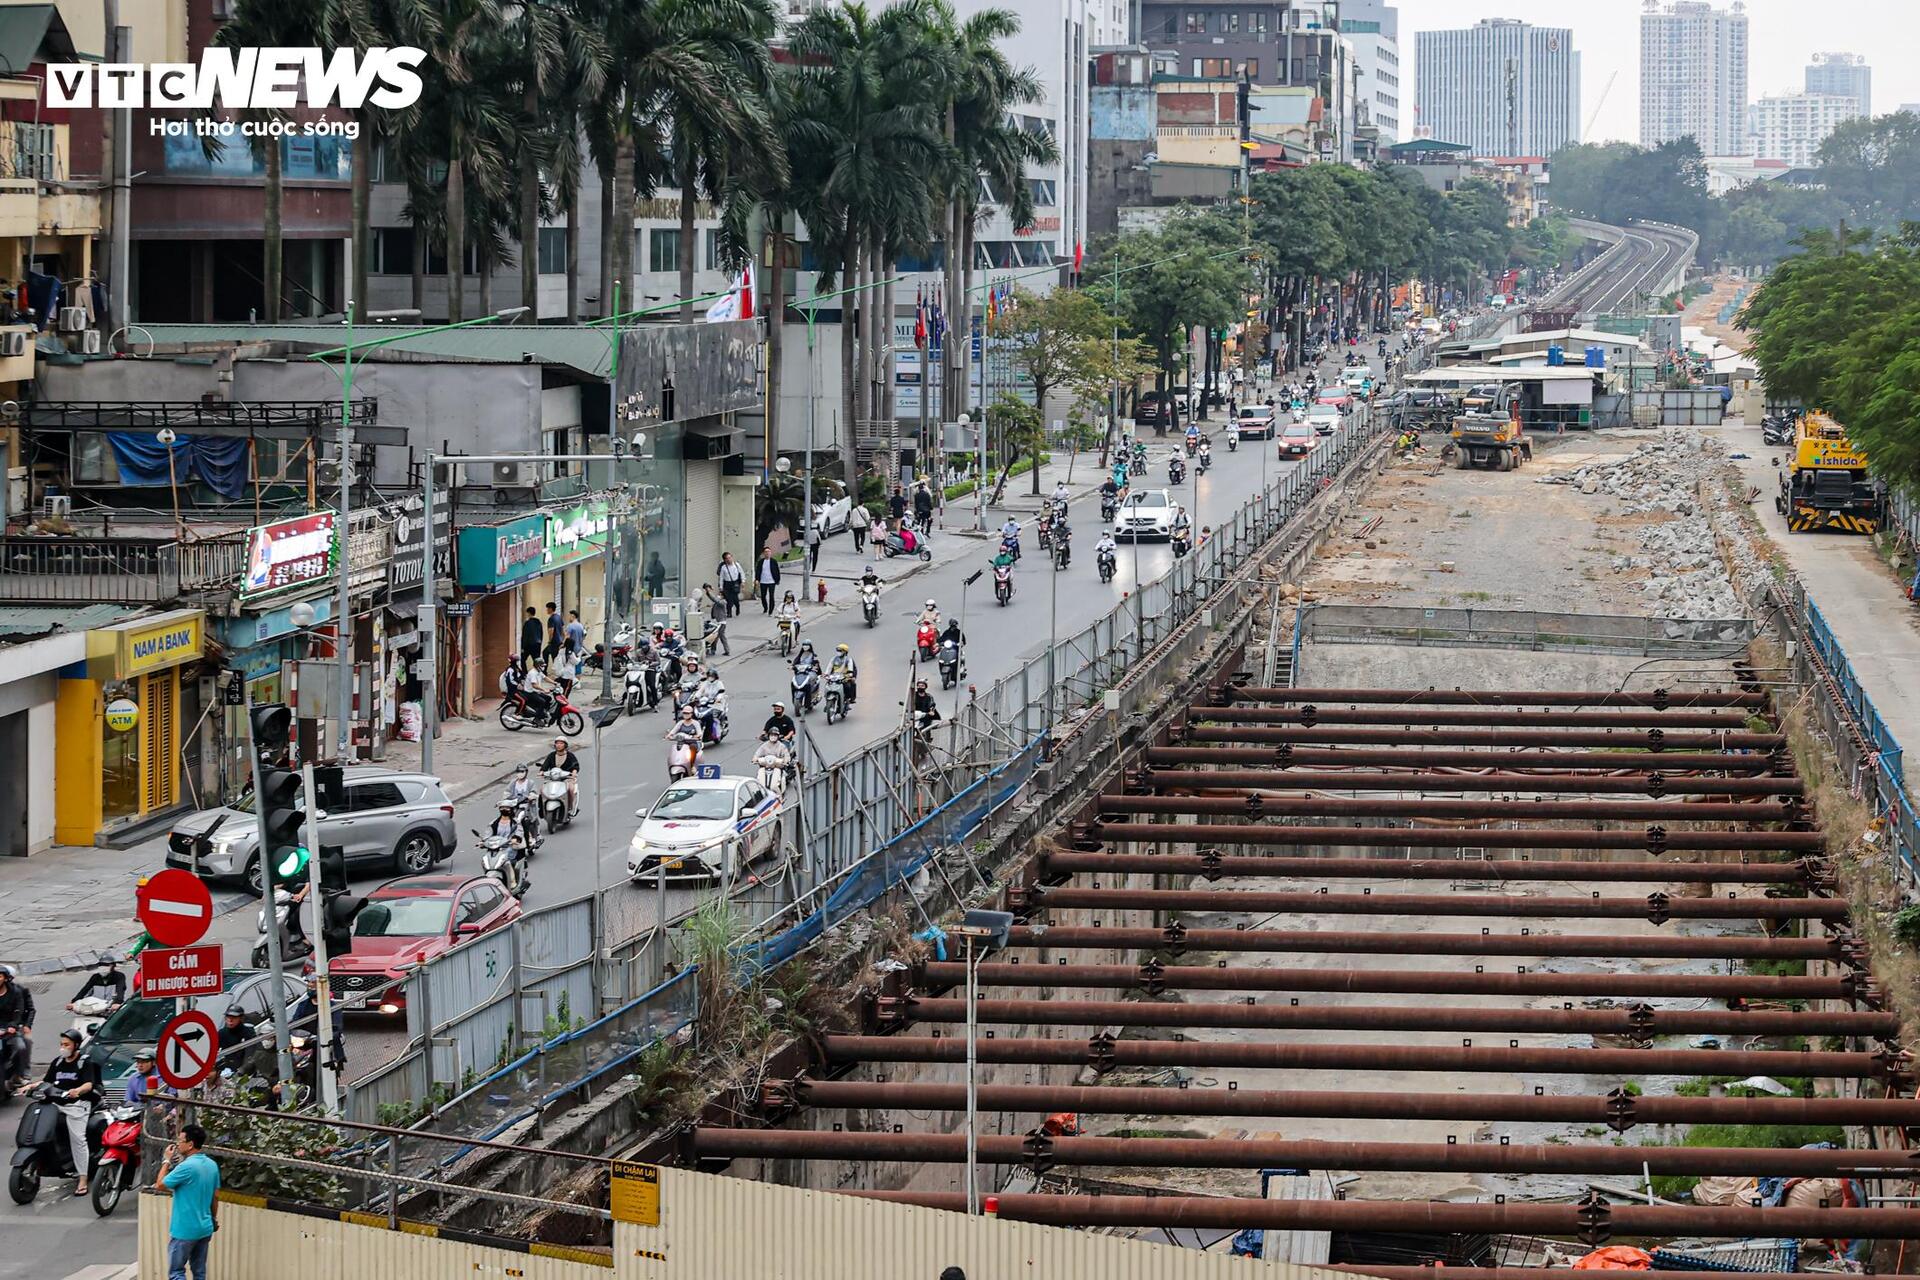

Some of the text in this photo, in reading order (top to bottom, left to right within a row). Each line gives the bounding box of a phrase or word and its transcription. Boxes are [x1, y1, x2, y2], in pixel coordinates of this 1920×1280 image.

[1823, 457, 1858, 466] ishida
[134, 629, 191, 659] NAM A BANK
[111, 716, 132, 725] ATM
[169, 949, 198, 970] CẤM
[158, 976, 189, 992] NGƯỢC
